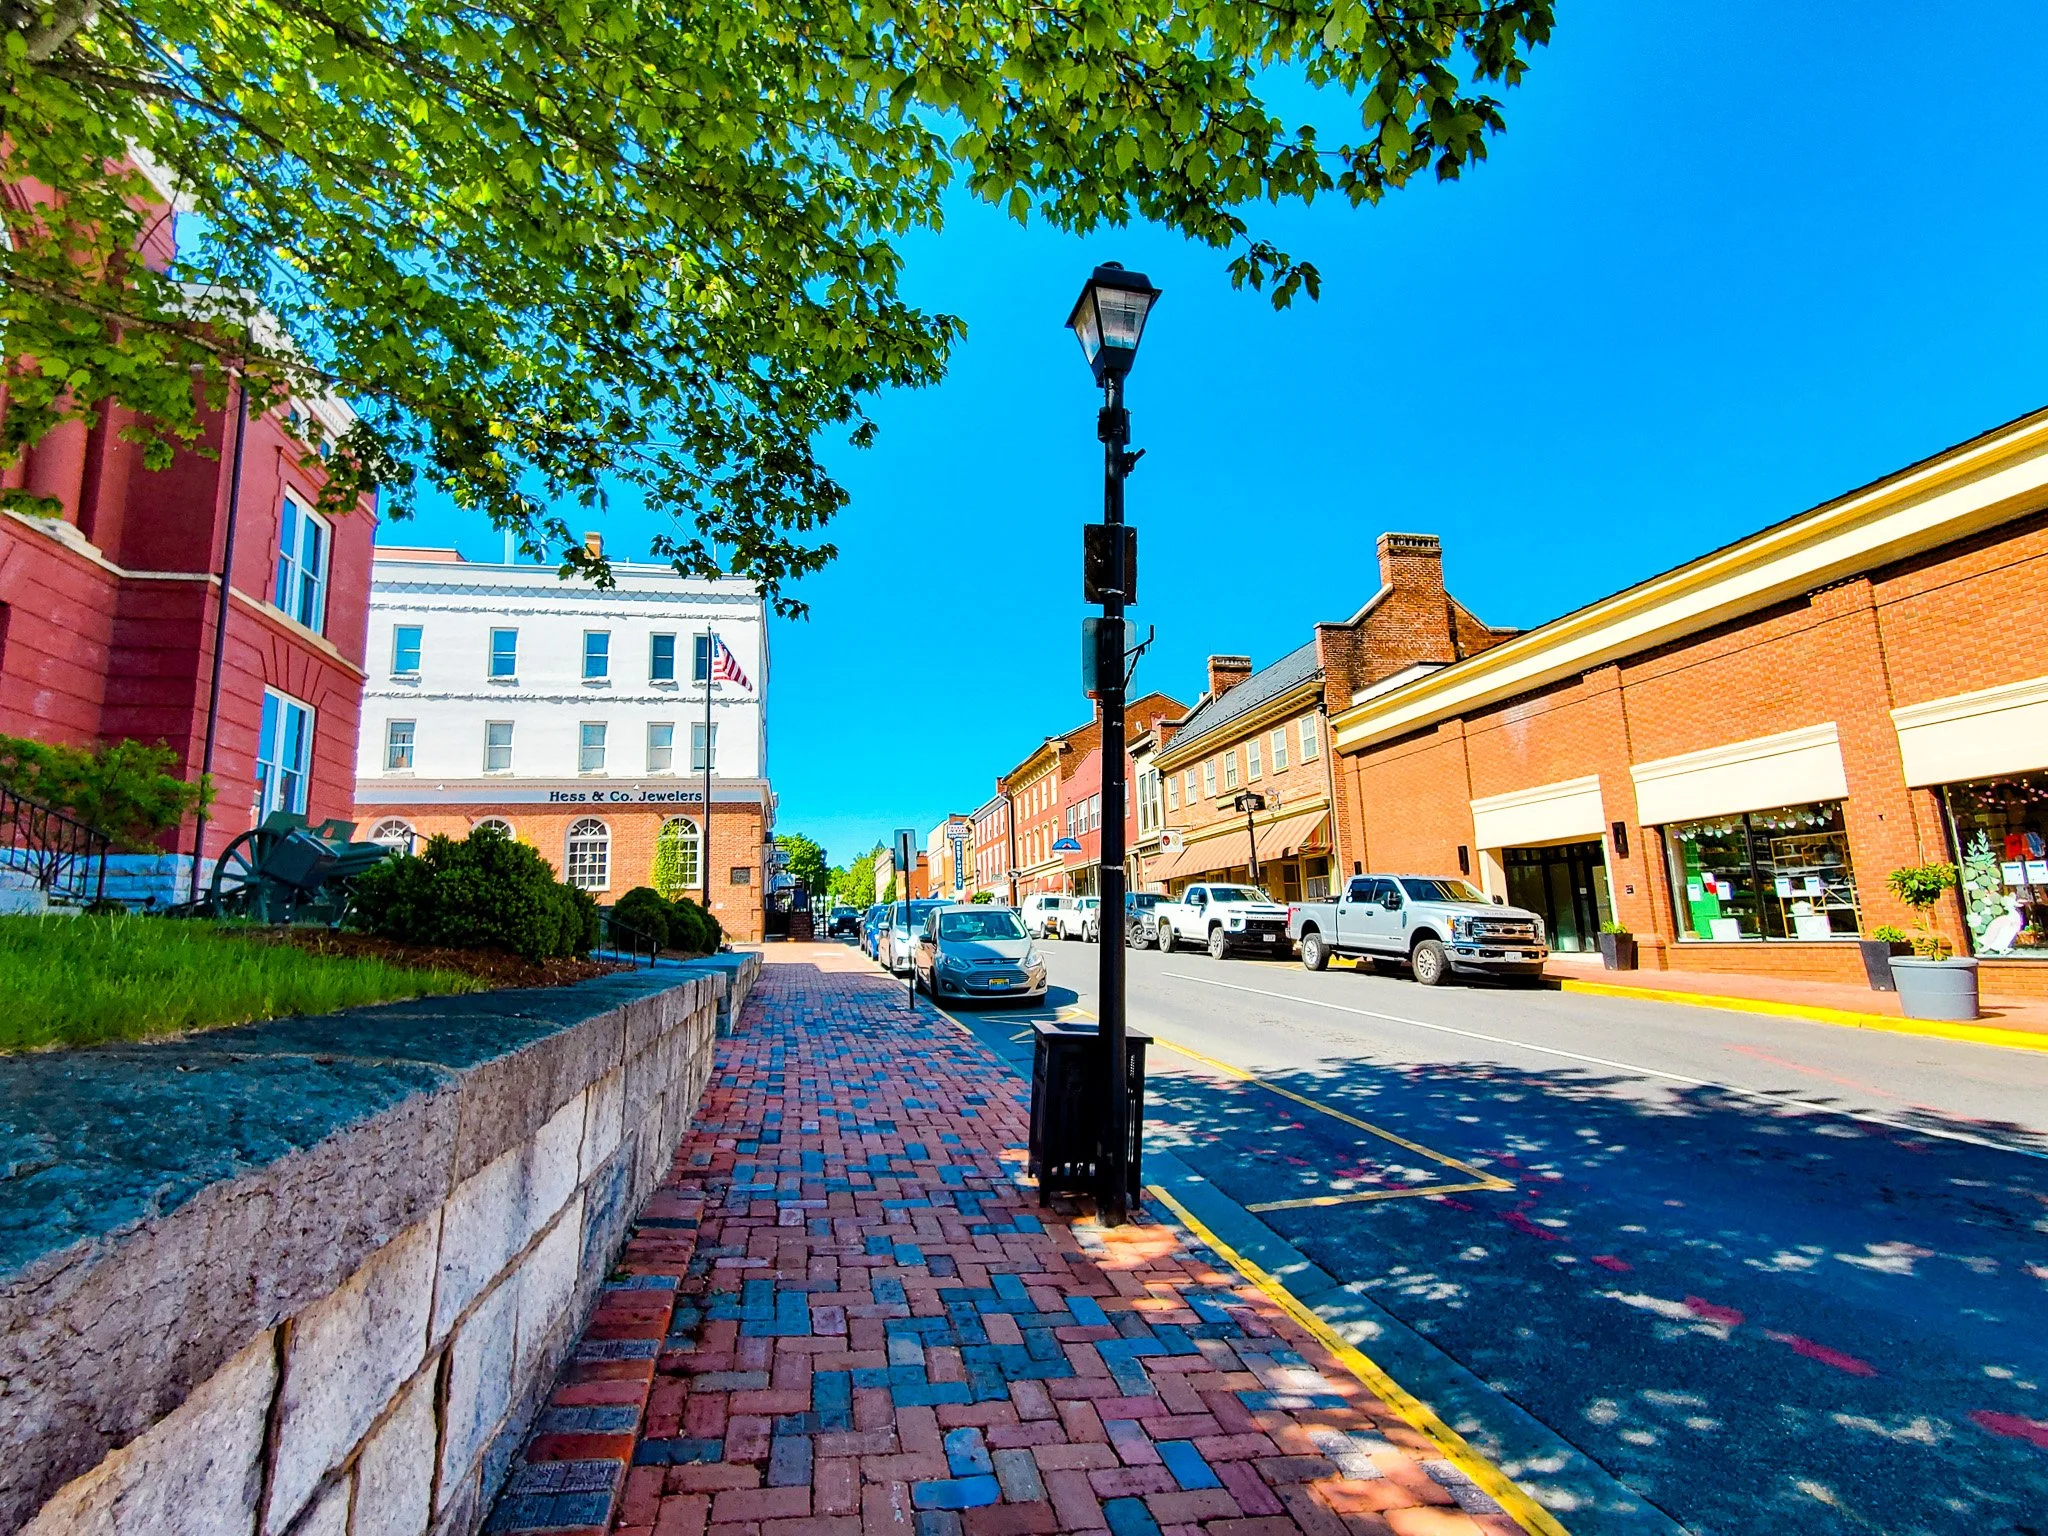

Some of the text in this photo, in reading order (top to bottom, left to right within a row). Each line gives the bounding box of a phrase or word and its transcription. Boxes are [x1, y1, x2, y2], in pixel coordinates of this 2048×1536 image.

[550, 791, 702, 802] Hess & Co. Jewelers
